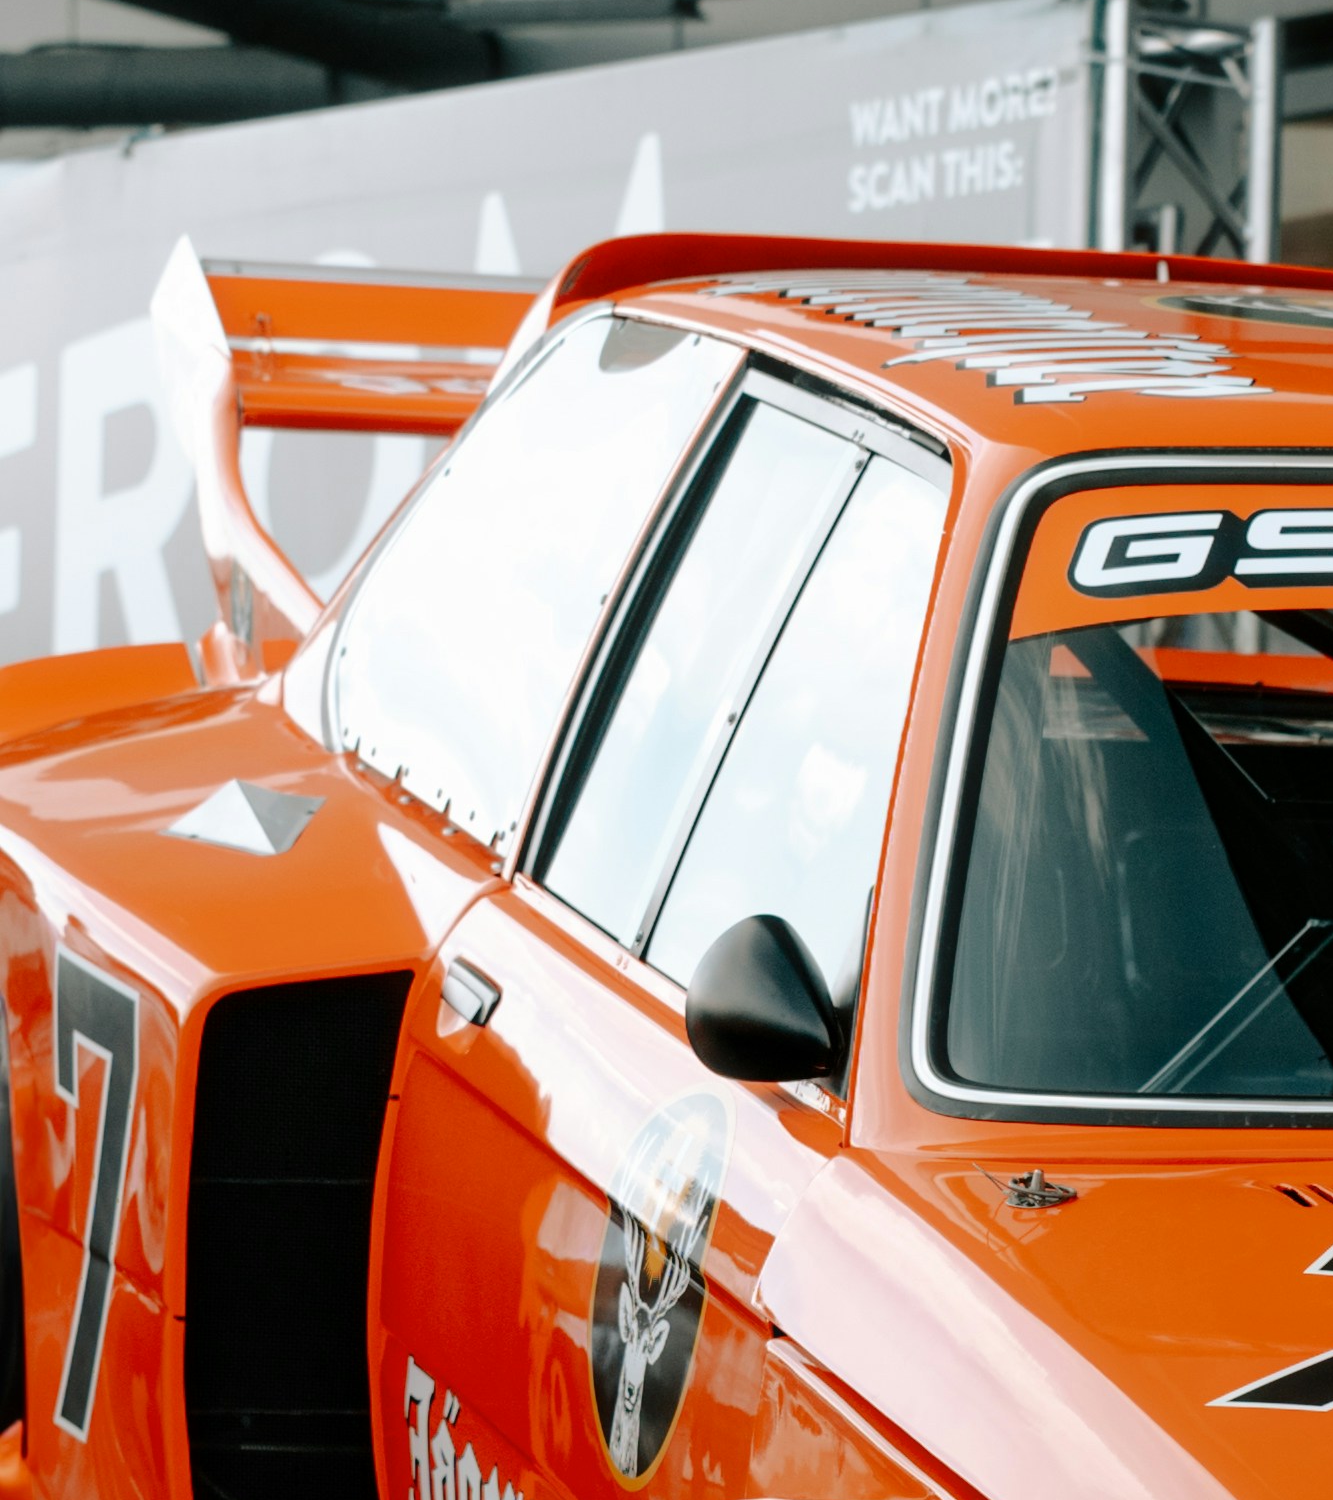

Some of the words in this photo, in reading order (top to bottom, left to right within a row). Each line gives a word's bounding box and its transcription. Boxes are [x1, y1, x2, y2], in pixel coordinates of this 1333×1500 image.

[850, 86, 945, 147] WANT
[848, 153, 935, 213] SCAN
[53, 943, 139, 1444] 7
